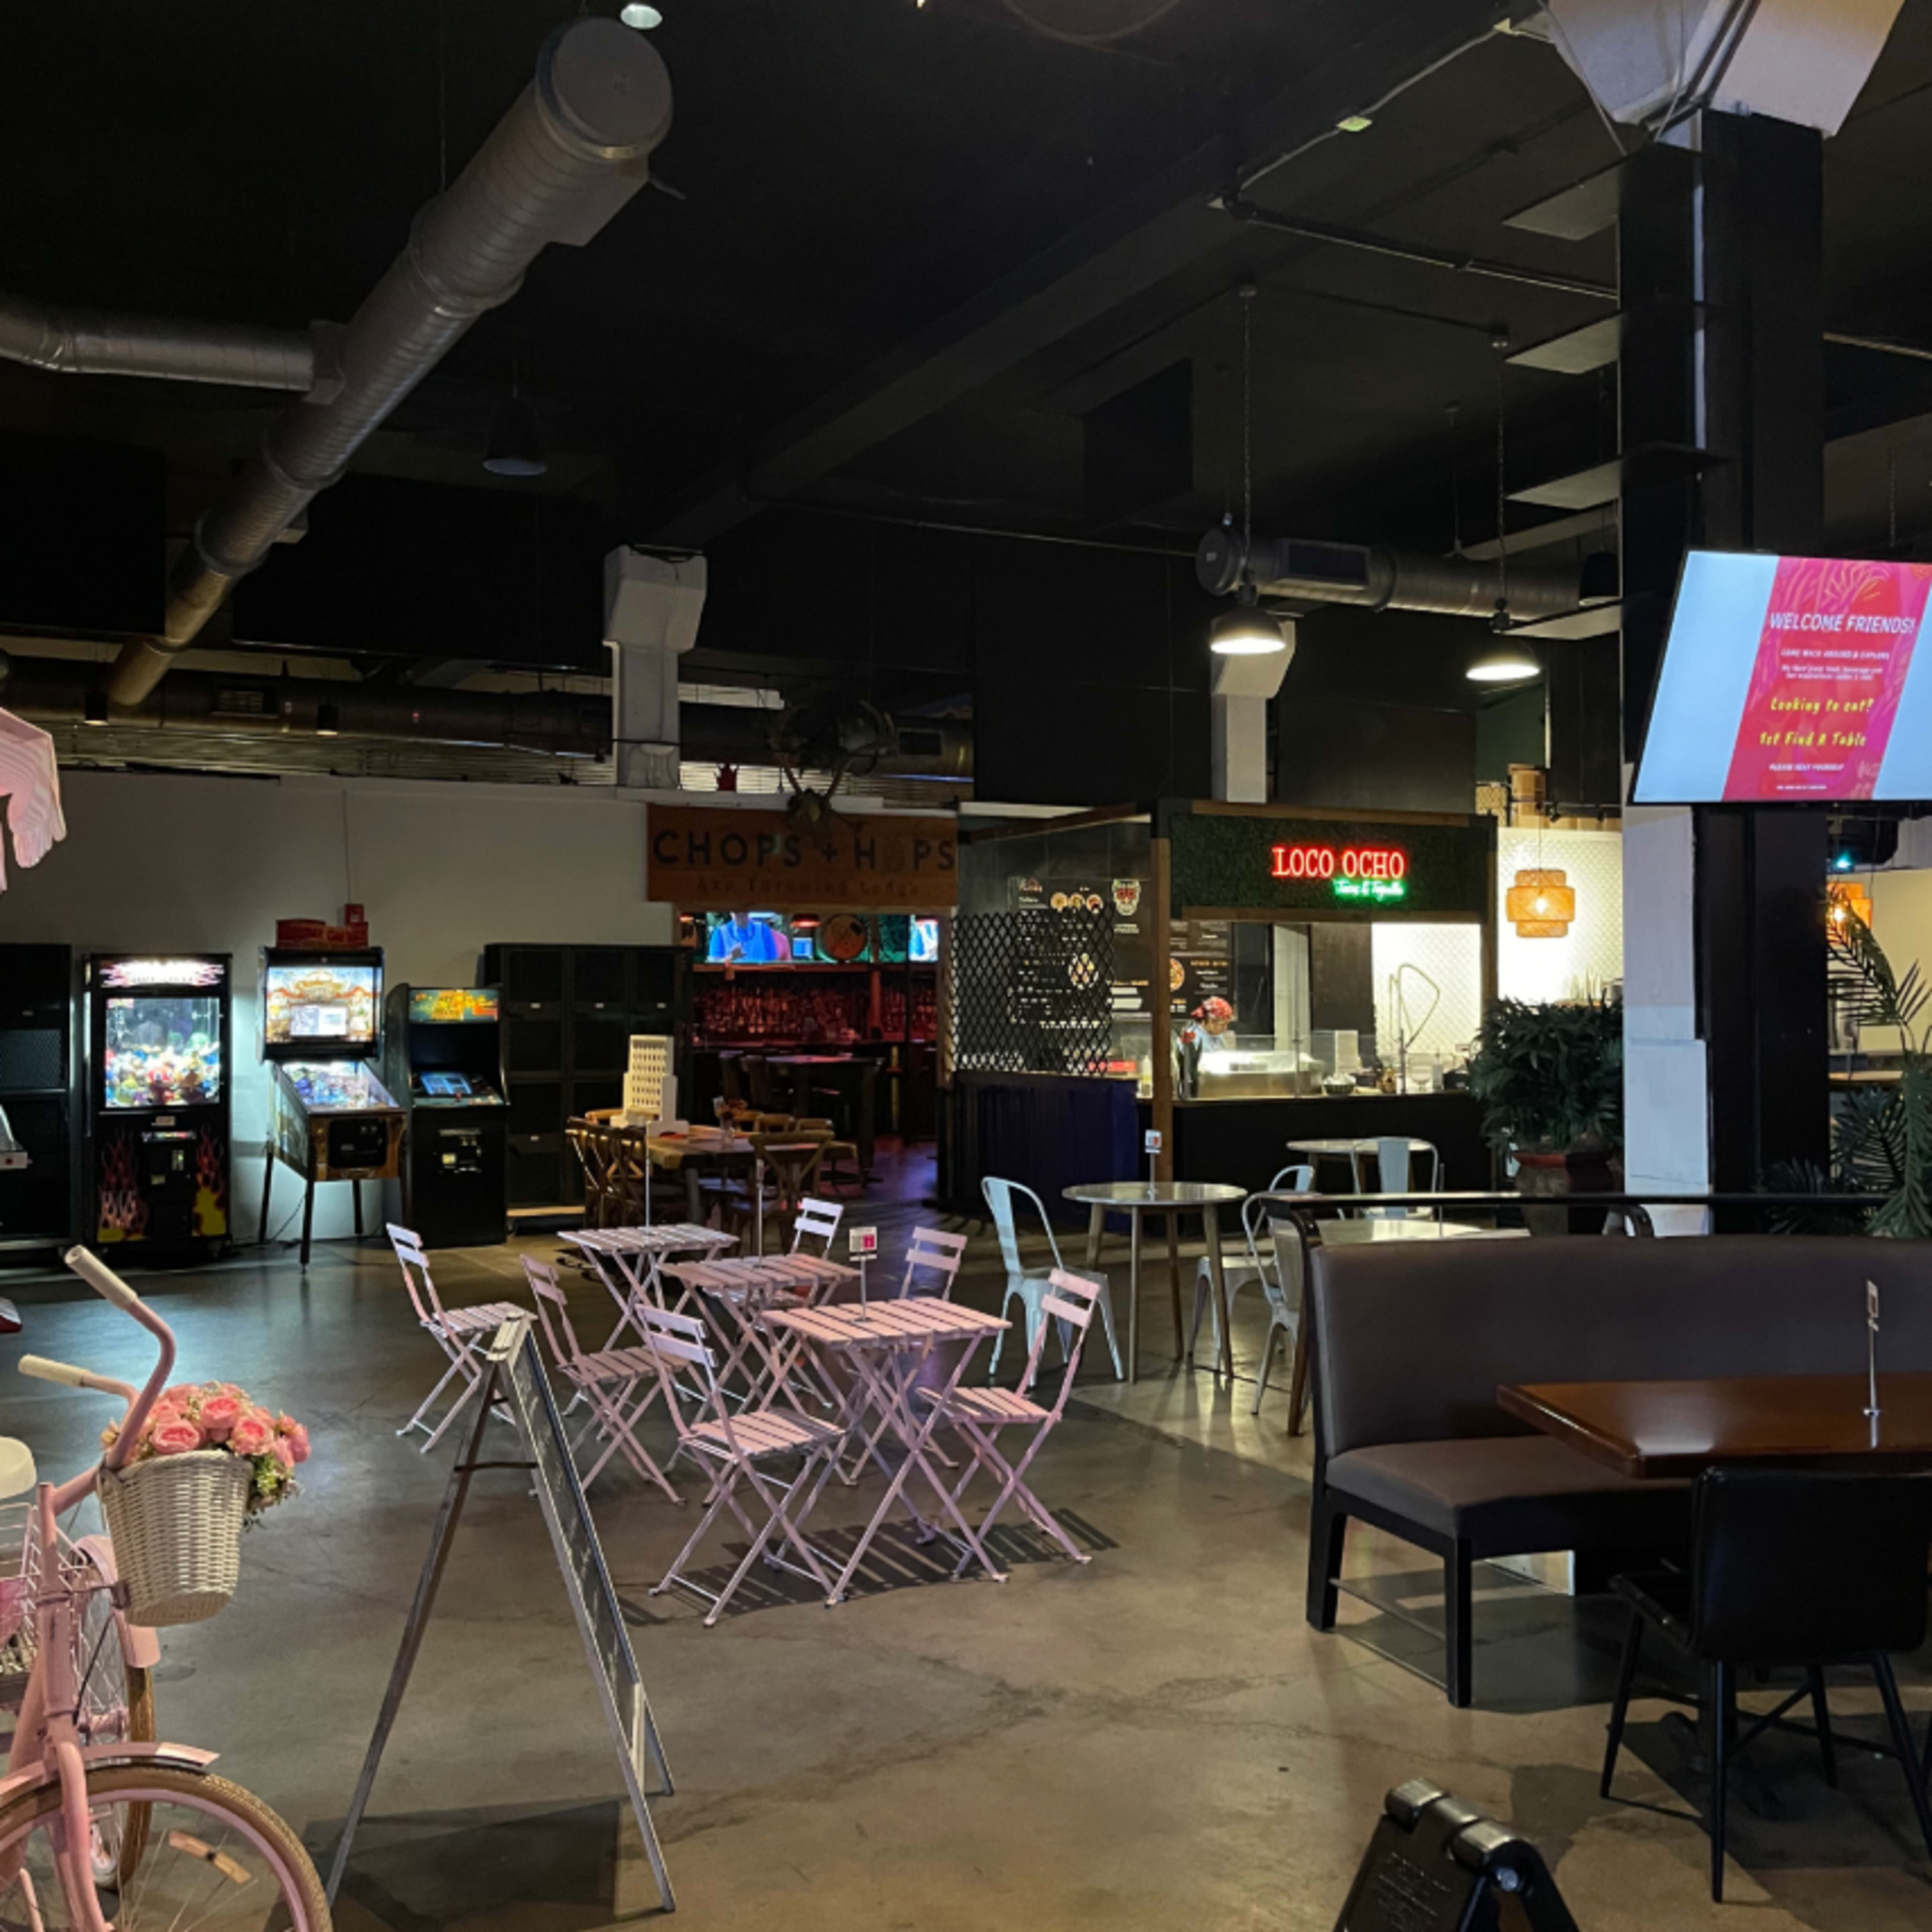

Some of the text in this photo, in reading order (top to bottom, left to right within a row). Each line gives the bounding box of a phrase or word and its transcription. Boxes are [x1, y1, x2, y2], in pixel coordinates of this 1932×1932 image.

[1770, 612, 1915, 633] WELCOME FRIENDS!
[1770, 697, 1819, 714] Looking
[1825, 698, 1839, 712] to
[1785, 732, 1814, 746] Find
[1817, 733, 1827, 746] A
[1832, 732, 1867, 746] Table
[653, 829, 802, 868] CHOPS
[1272, 848, 1404, 878] LOCO OCHO
